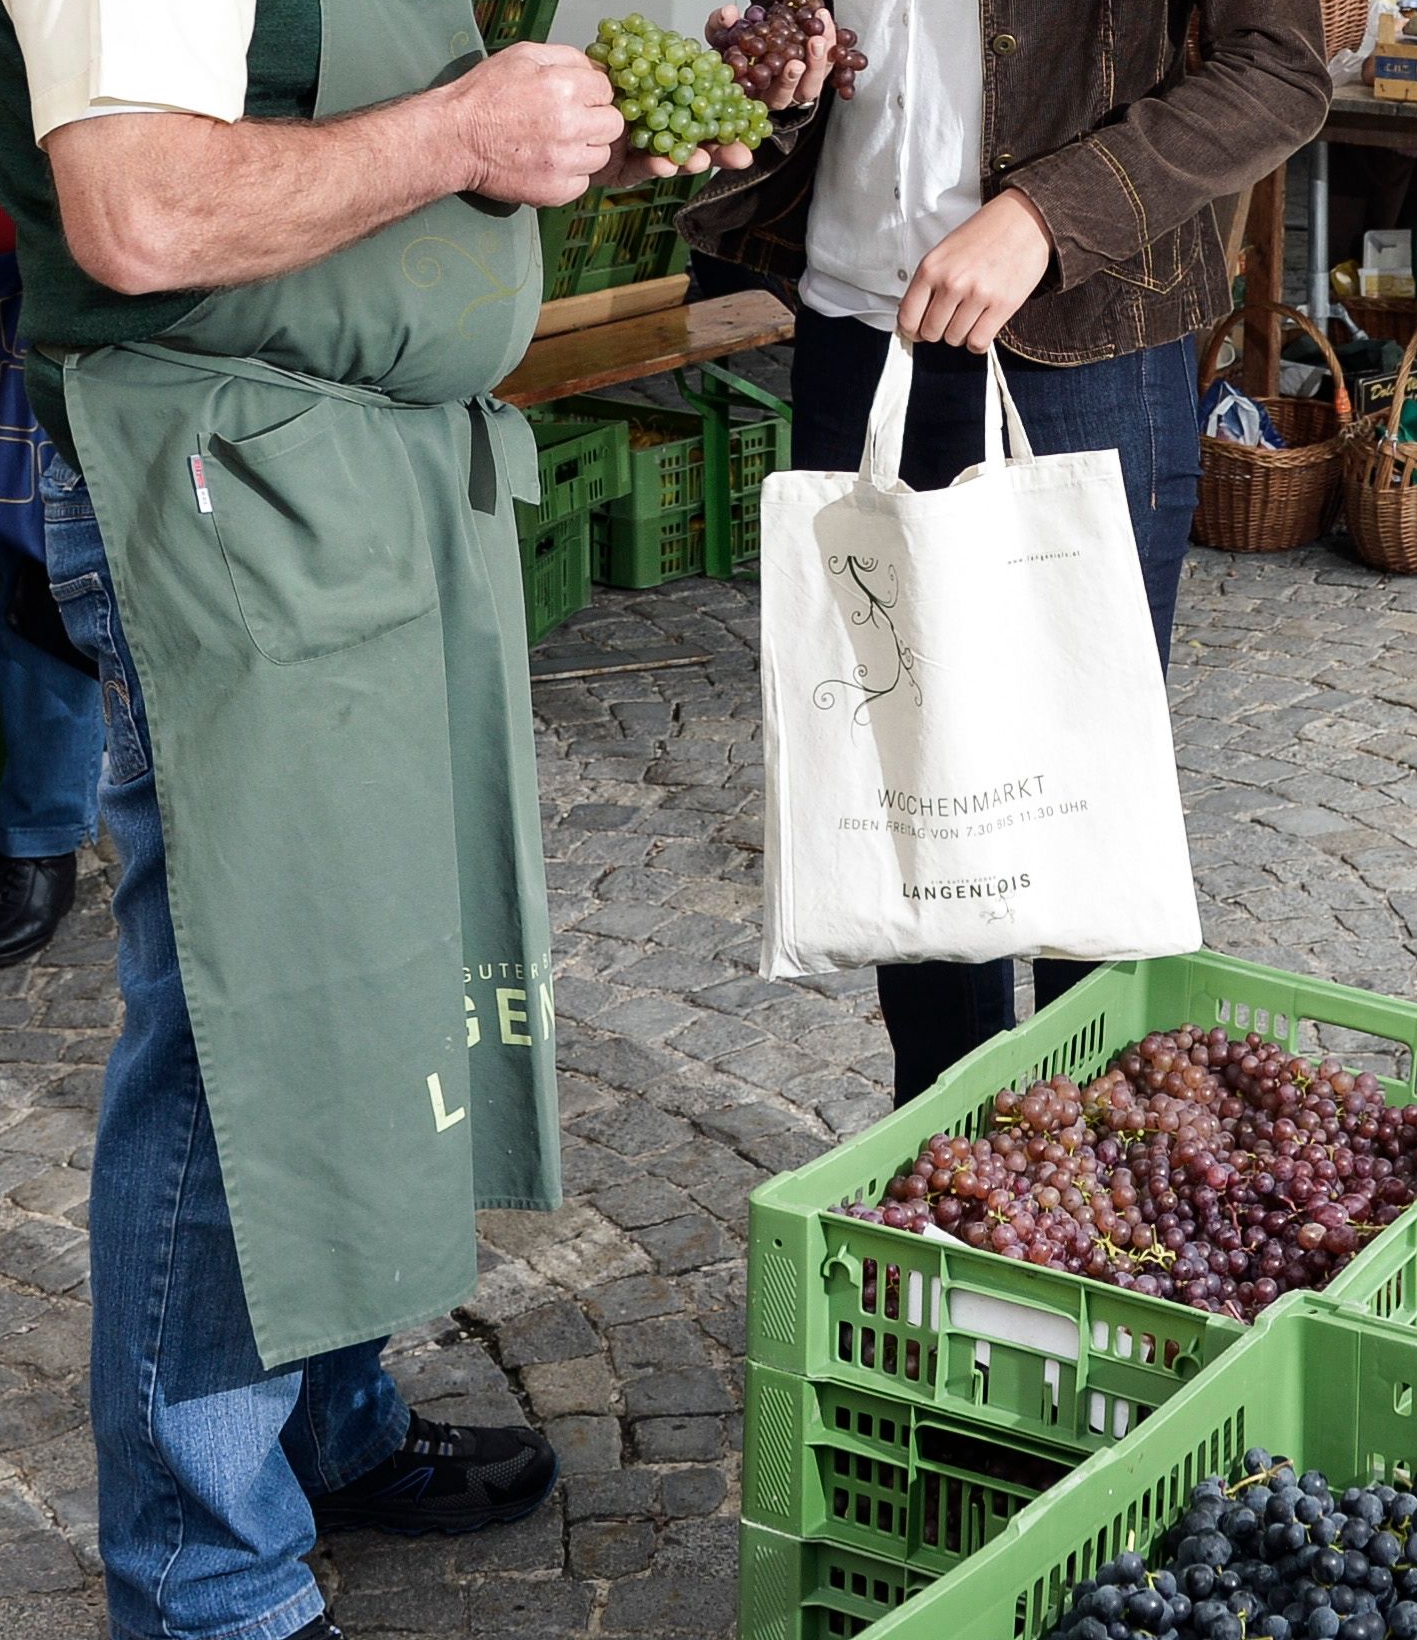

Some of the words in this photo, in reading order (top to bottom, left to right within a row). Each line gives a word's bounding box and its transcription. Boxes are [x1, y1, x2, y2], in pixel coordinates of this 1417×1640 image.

[878, 774, 1046, 818] WOCHENMARKT
[838, 817, 879, 831] JEDEN
[885, 819, 926, 840] FREITAG
[931, 827, 960, 840] VON
[966, 821, 994, 838] 7.30
[997, 817, 1014, 830] BIS
[1019, 805, 1055, 822] 11.30
[1060, 799, 1089, 815] UHR
[902, 872, 1031, 901] LANGENLOIS
